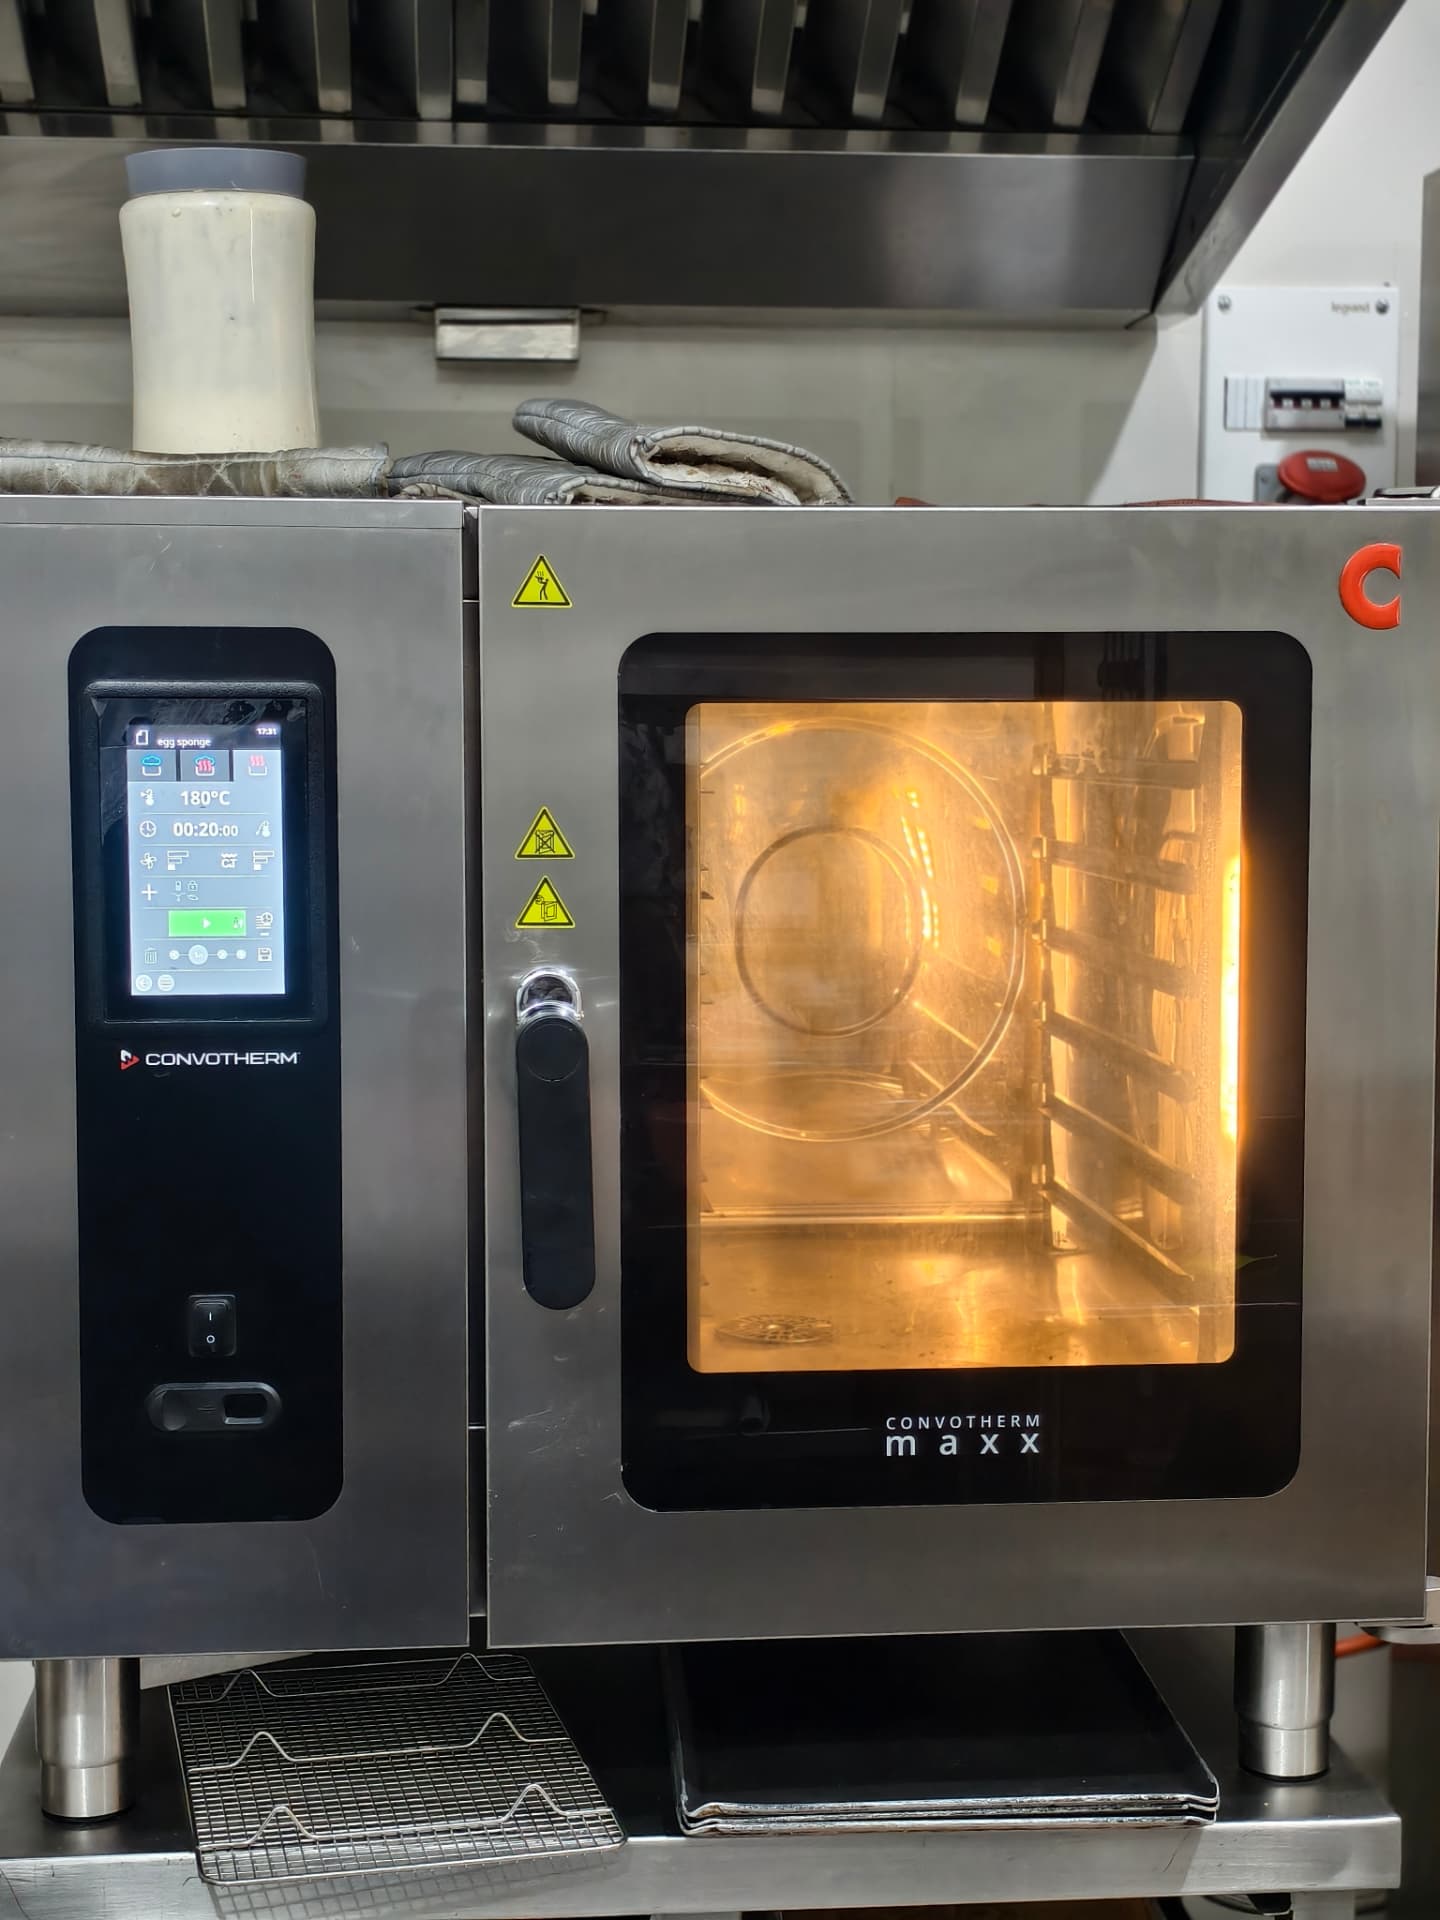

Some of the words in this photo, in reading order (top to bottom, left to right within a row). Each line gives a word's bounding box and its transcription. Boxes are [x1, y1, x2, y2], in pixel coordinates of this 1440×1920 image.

[157, 738, 175, 749] egg
[177, 738, 212, 749] sponge
[145, 1052, 298, 1066] CONVOTHERM
[886, 1414, 1041, 1430] CONVOTHERM
